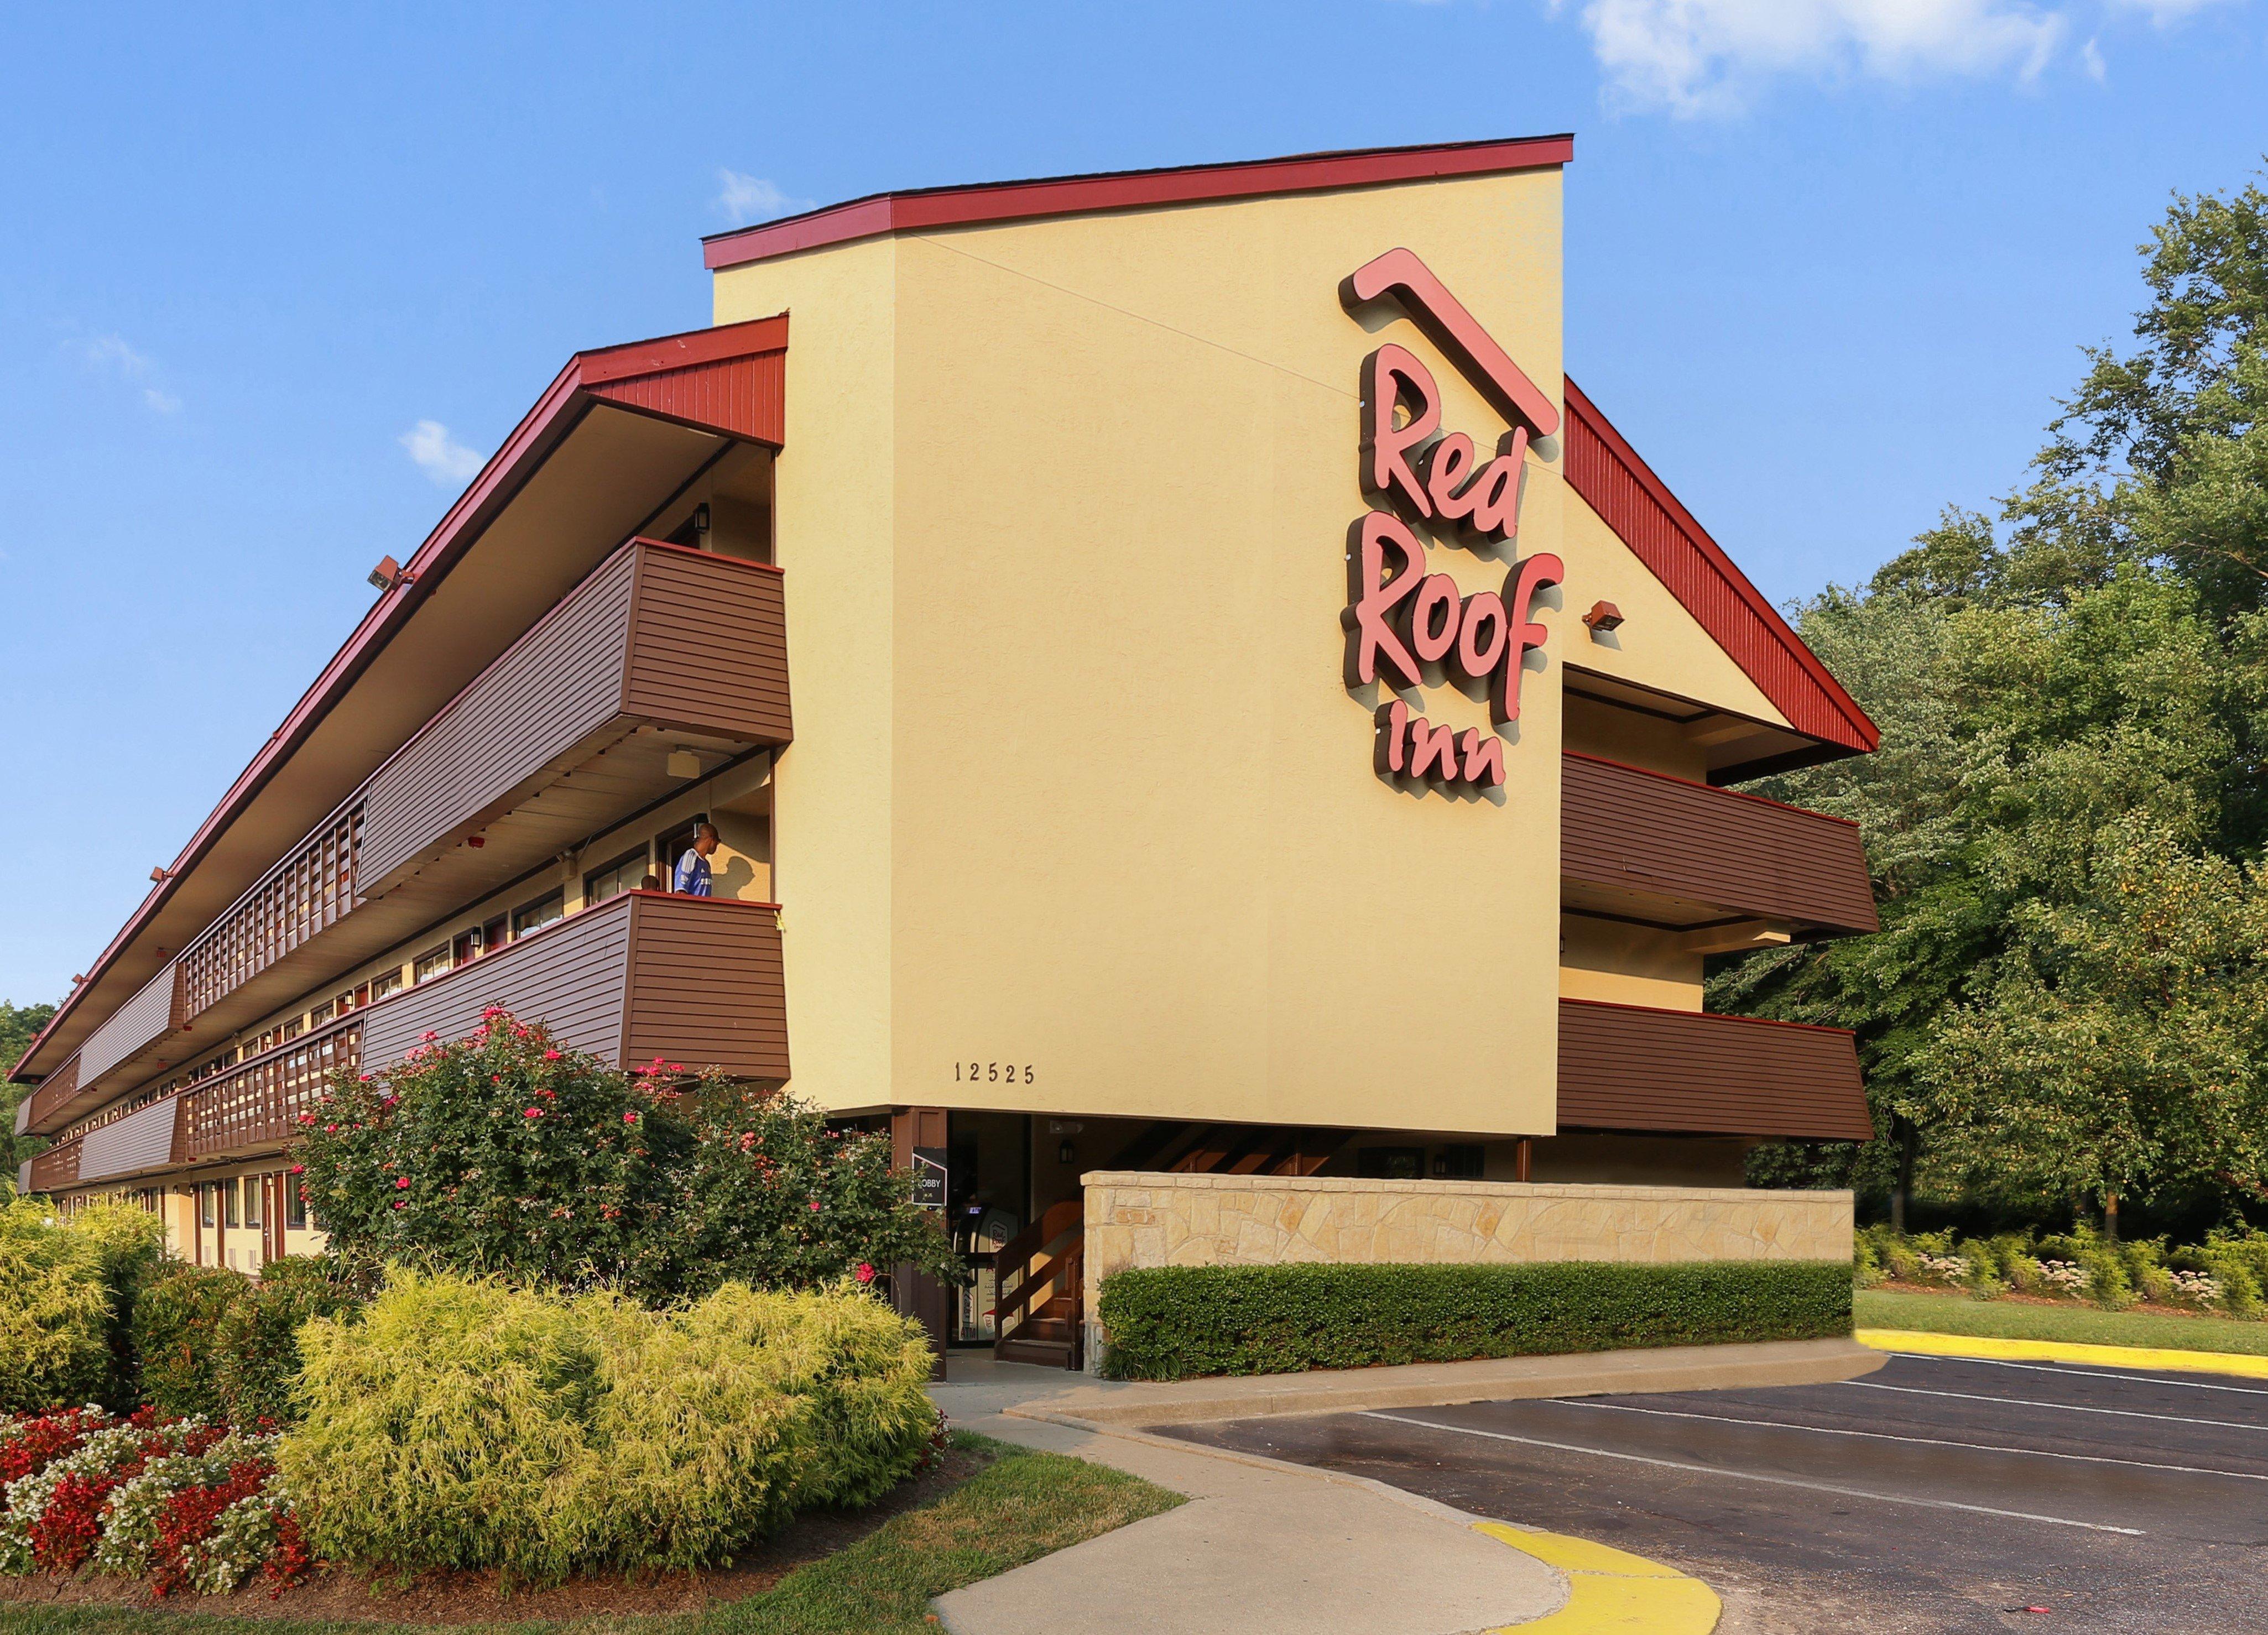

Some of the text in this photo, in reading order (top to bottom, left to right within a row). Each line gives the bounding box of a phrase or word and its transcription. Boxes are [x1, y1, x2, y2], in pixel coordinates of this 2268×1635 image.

[1373, 343, 1529, 539] Red
[1355, 509, 1564, 722] Roof
[1389, 698, 1506, 786] Inn
[955, 1061, 1034, 1084] 12525
[920, 1178, 941, 1188] OBBY
